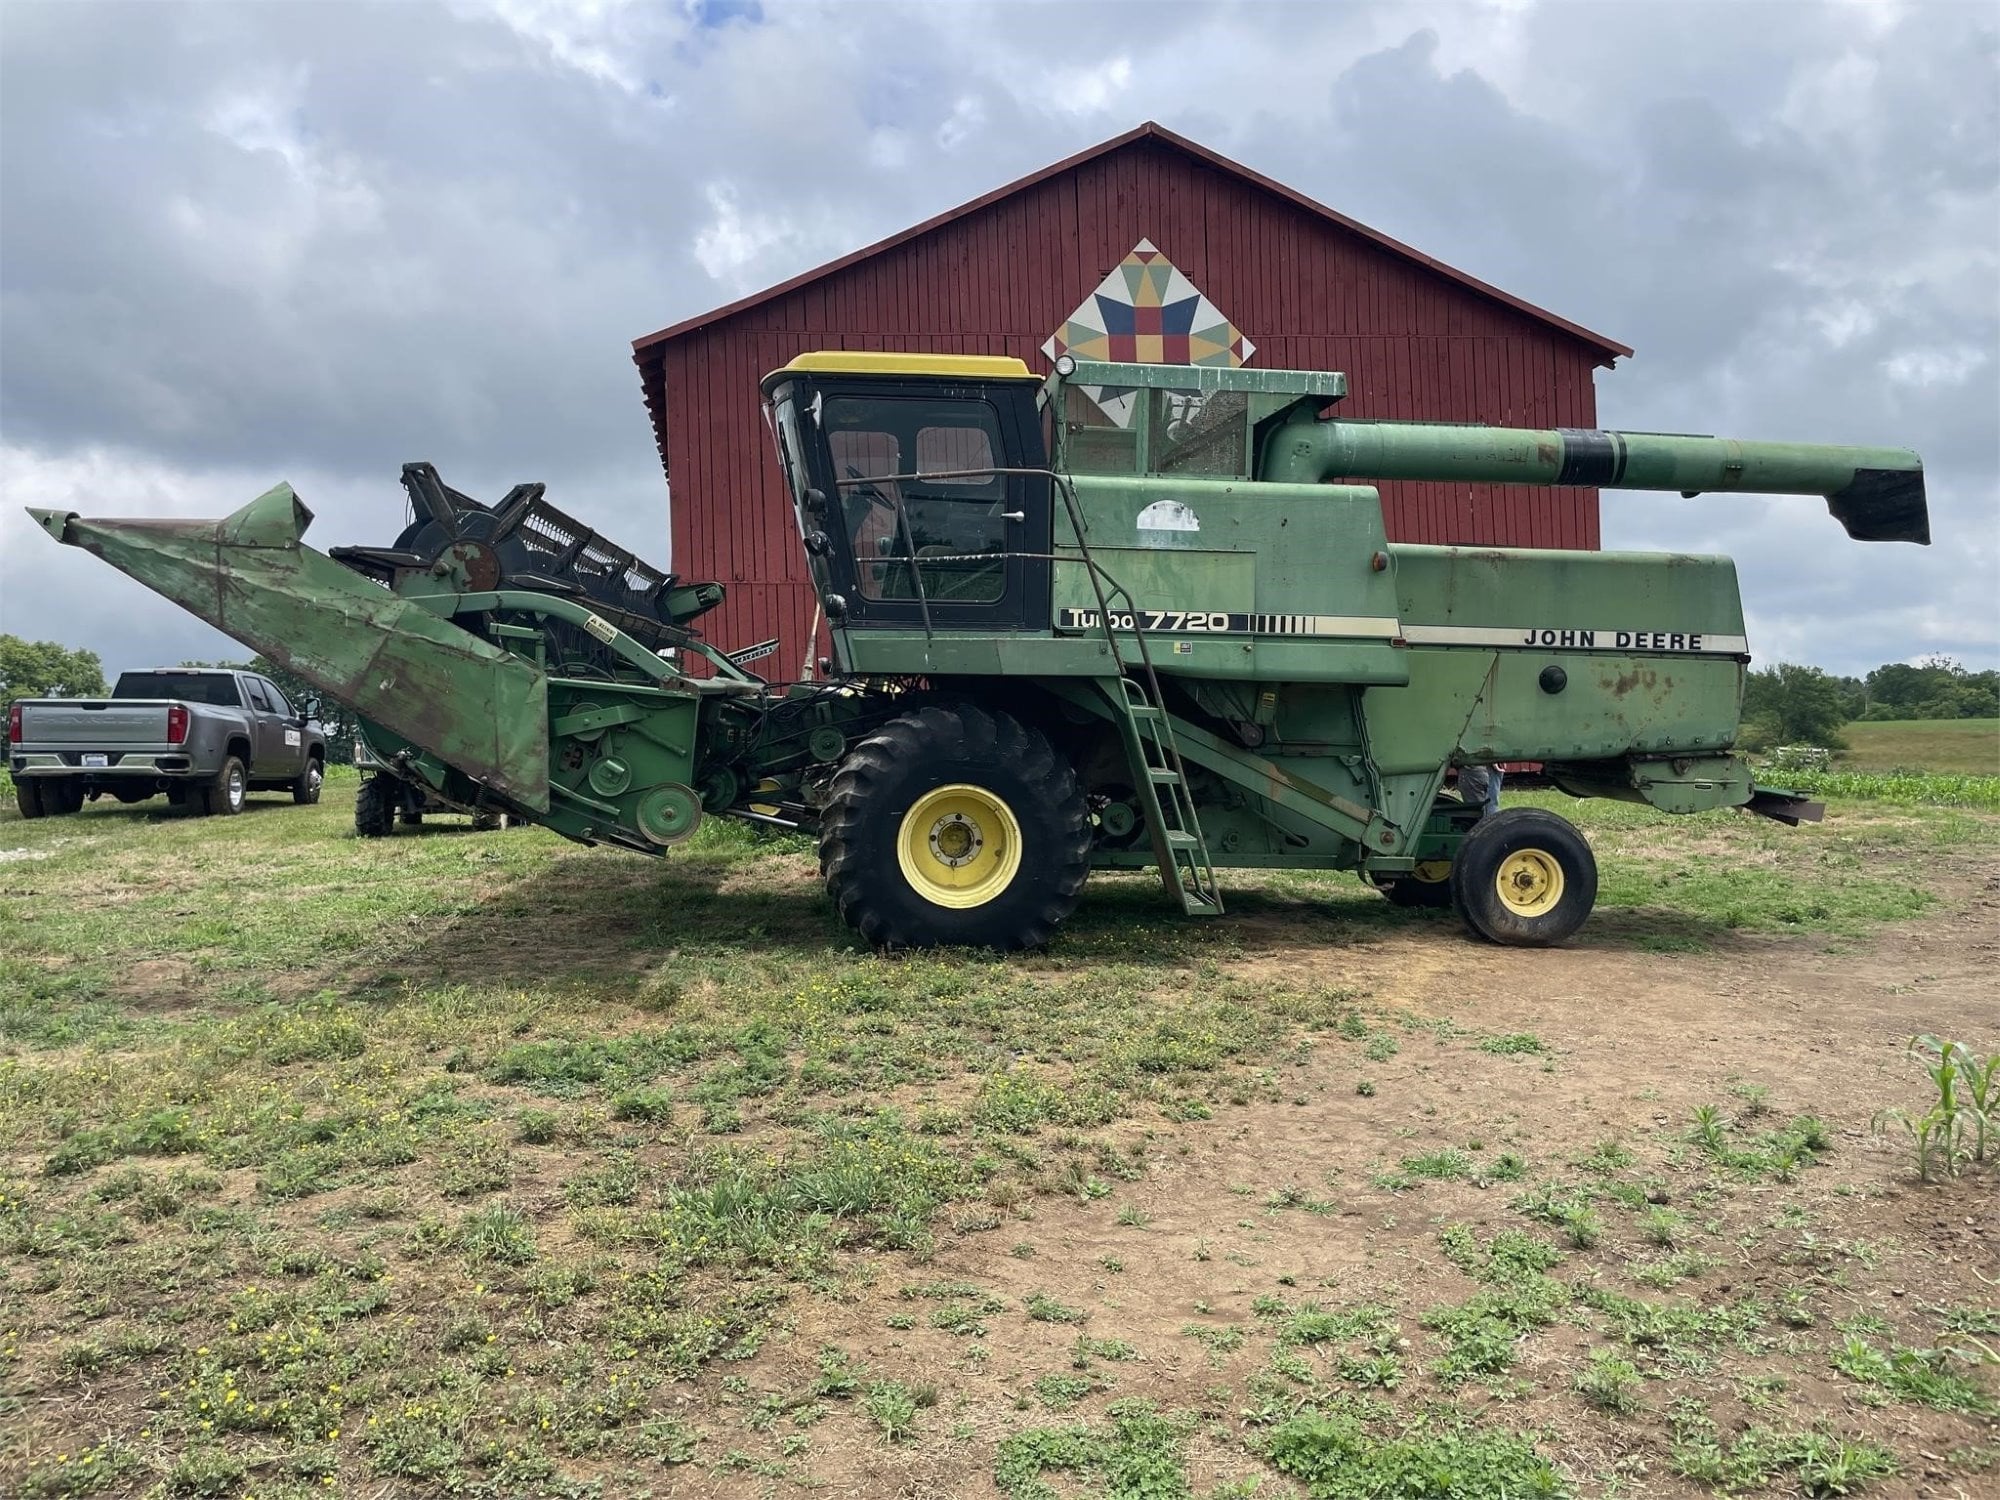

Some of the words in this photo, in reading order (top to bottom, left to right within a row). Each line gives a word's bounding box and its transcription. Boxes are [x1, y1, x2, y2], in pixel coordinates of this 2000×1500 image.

[1145, 611, 1229, 631] 7720
[1524, 630, 1595, 647] JOHN
[1616, 632, 1702, 650] DEERE
